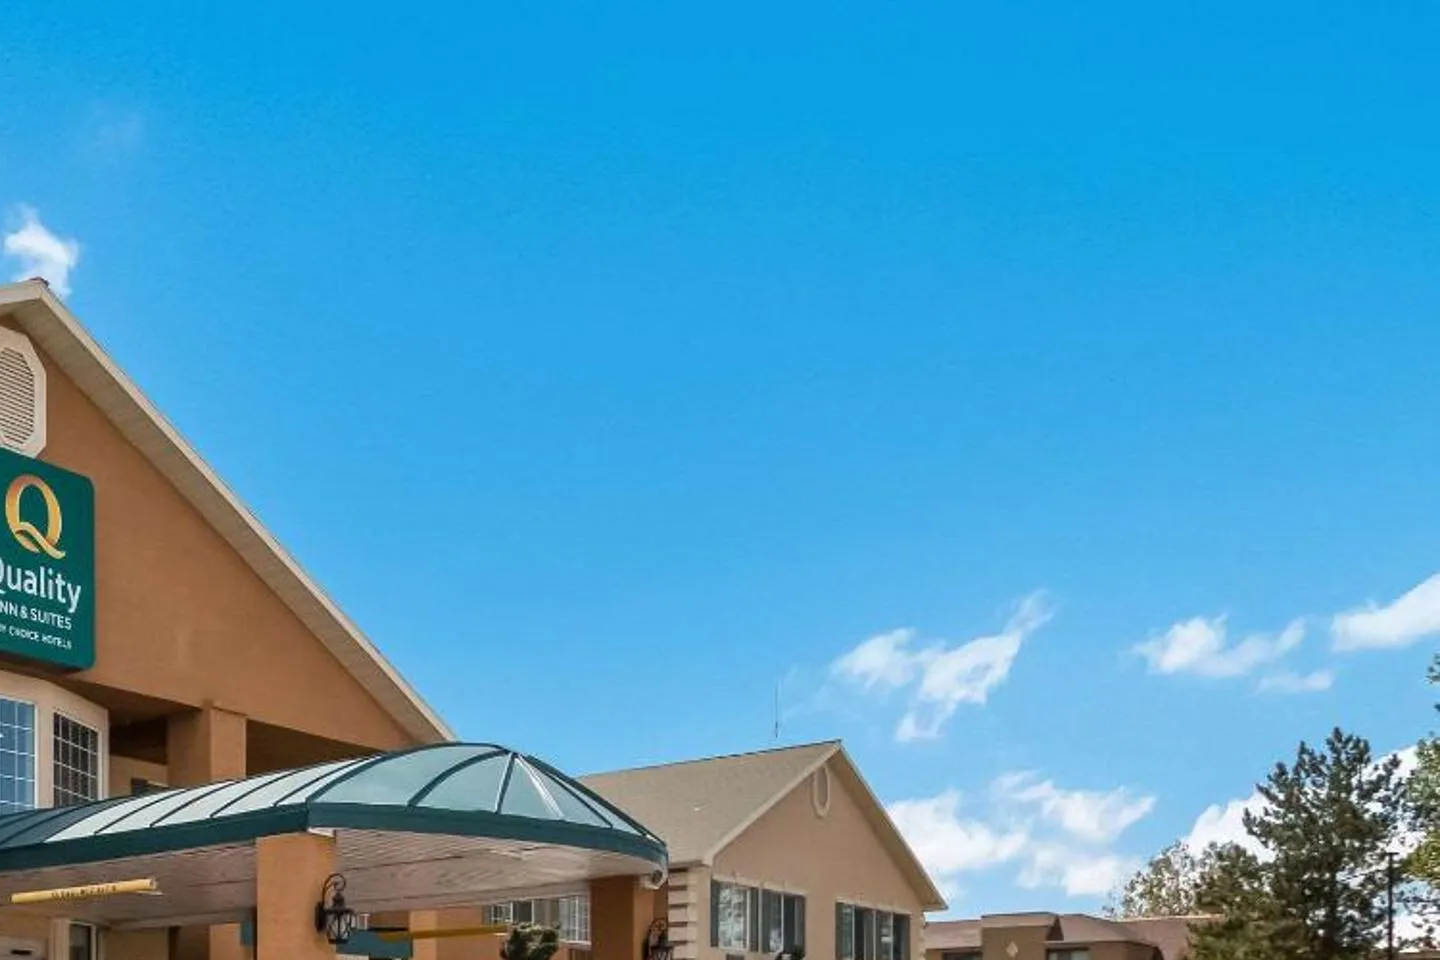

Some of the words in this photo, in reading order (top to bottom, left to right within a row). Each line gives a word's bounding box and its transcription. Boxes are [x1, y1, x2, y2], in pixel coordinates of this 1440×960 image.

[5, 474, 66, 559] Q
[20, 605, 28, 619] &
[30, 608, 72, 630] SUITES
